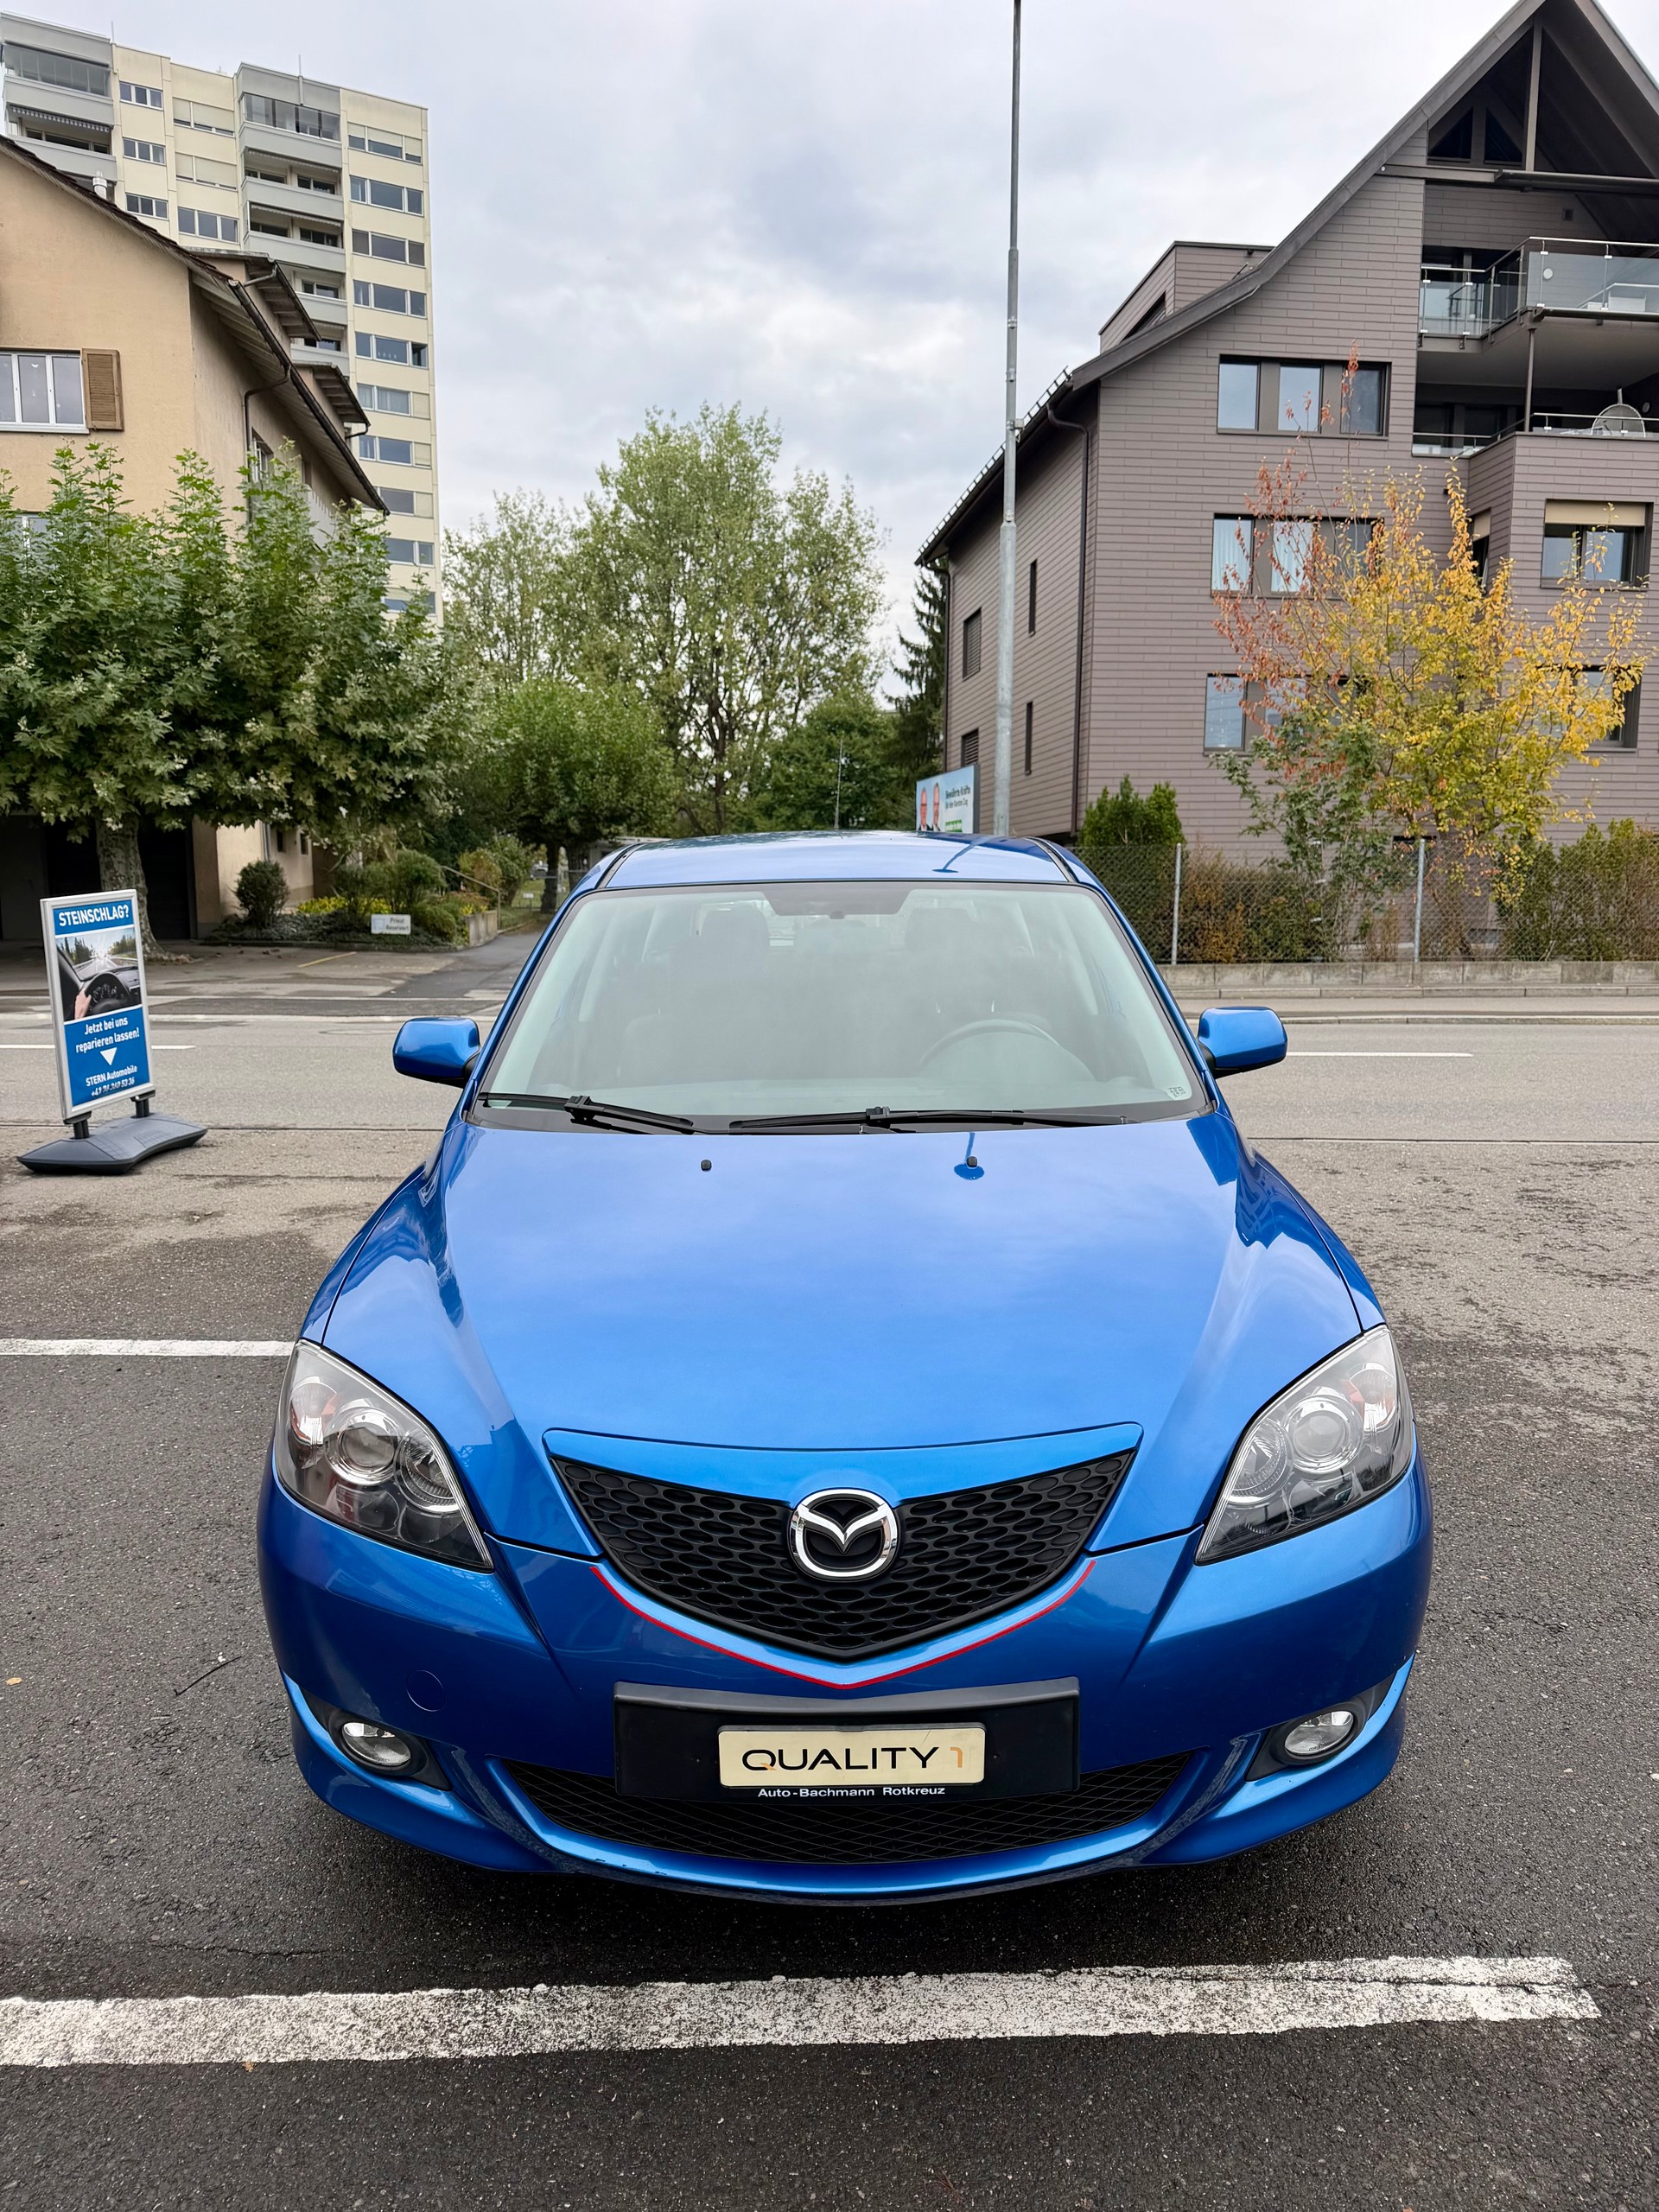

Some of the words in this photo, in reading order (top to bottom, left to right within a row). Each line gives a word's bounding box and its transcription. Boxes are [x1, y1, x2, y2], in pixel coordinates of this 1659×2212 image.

[59, 904, 129, 927] STEINSCHLAG?
[84, 1021, 103, 1035] Jetzt
[103, 1018, 115, 1031] bei
[115, 1017, 129, 1028] uns
[75, 1037, 113, 1053] reparieren
[113, 1027, 140, 1043] lassen!
[86, 1072, 106, 1087] STERN
[106, 1065, 138, 1081] Automobile
[741, 1746, 940, 1771] QUALITY
[950, 1746, 963, 1769] 1
[883, 1786, 945, 1796] Rotkreuz
